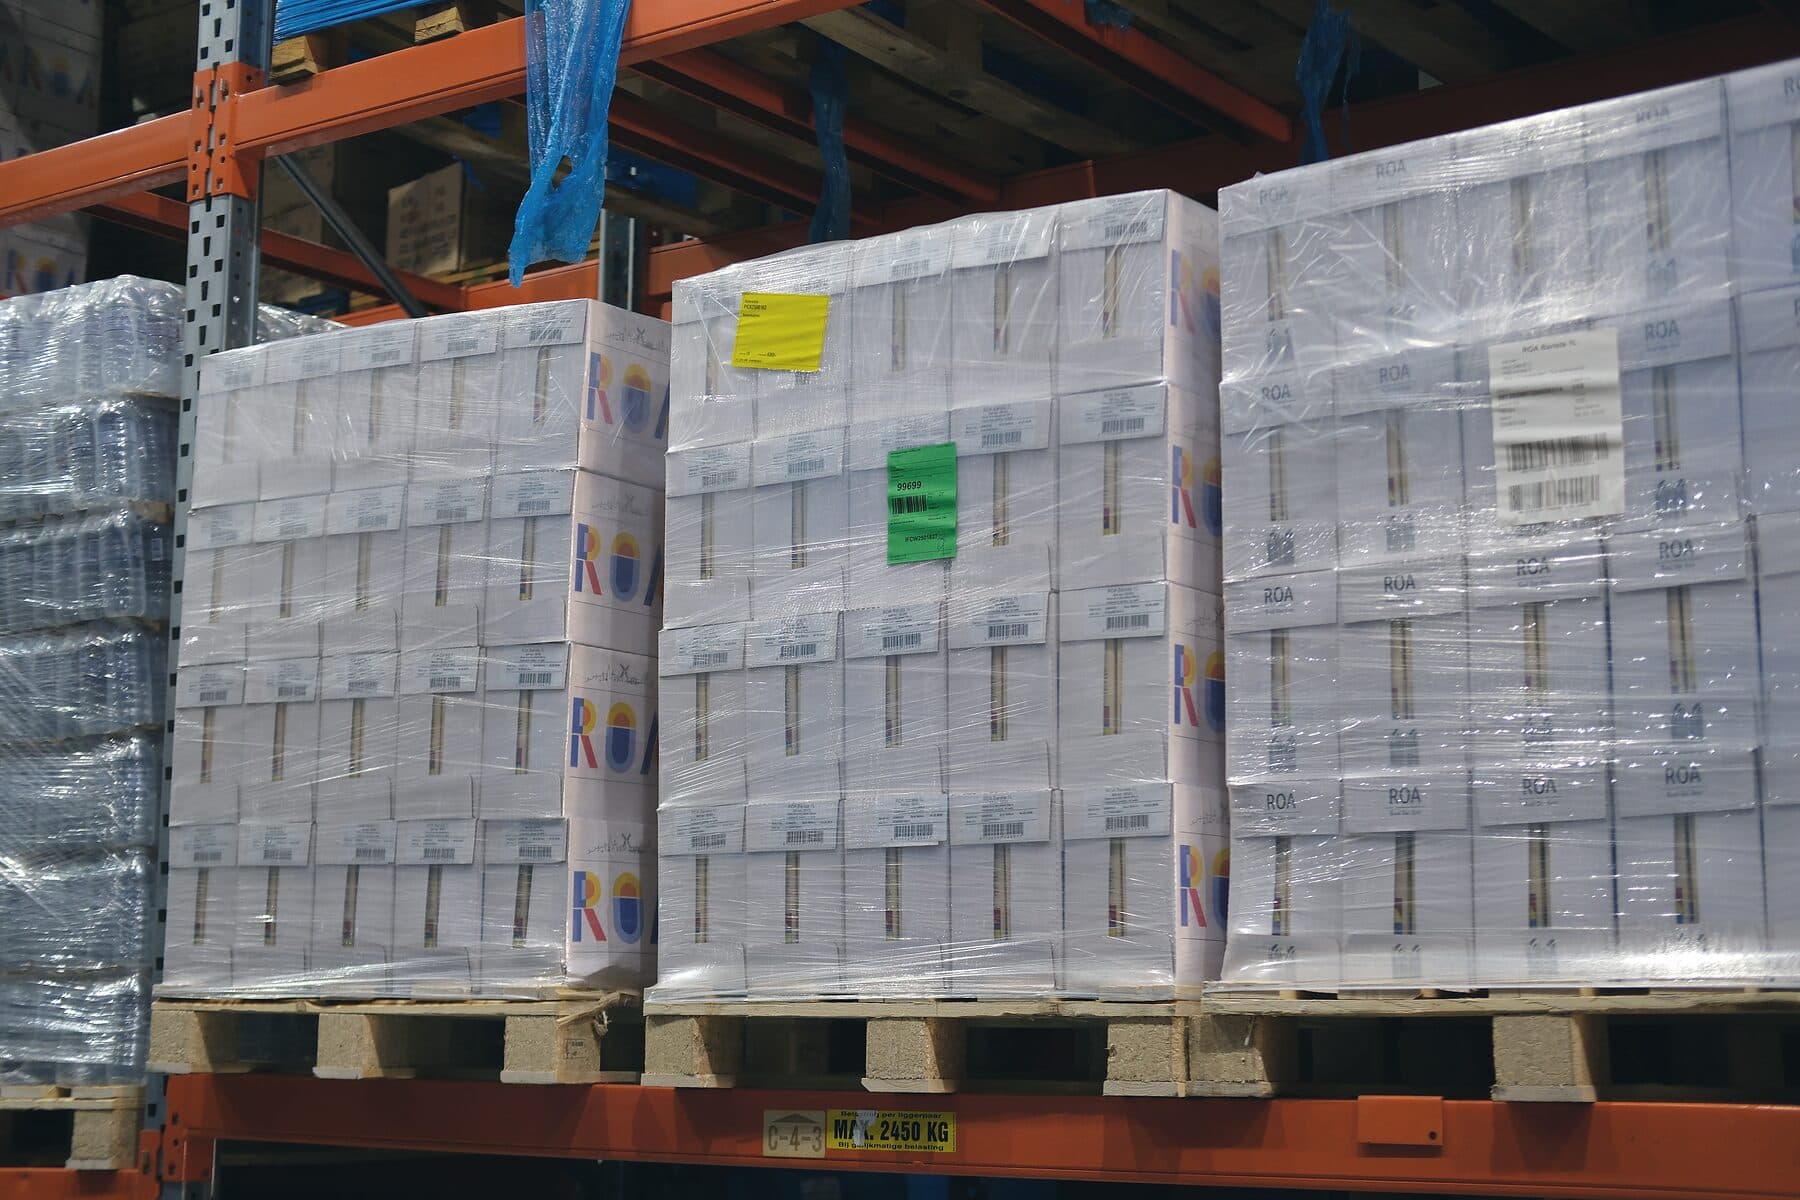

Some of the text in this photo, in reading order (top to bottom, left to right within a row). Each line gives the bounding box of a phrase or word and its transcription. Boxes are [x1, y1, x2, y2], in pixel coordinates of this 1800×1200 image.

[1375, 159, 1407, 180] ROA
[1643, 319, 1681, 342] ROA
[1378, 364, 1411, 384] ROA
[1261, 384, 1291, 401] ROA
[896, 480, 922, 492] 99699
[1659, 538, 1696, 560] ROA
[1515, 556, 1551, 577] ROA
[1383, 573, 1417, 593] ROA
[1263, 586, 1295, 605] ROA
[1664, 765, 1703, 785] ROA
[1388, 785, 1422, 805] ROA
[1521, 777, 1558, 796] ROA
[1266, 792, 1297, 811] ROA
[881, 1111, 897, 1120] per
[767, 1124, 823, 1152] C-4-3
[879, 1120, 922, 1143] 2450
[927, 1121, 949, 1143] KG
[838, 1141, 850, 1150] Bij
[904, 1143, 945, 1152] belasting
